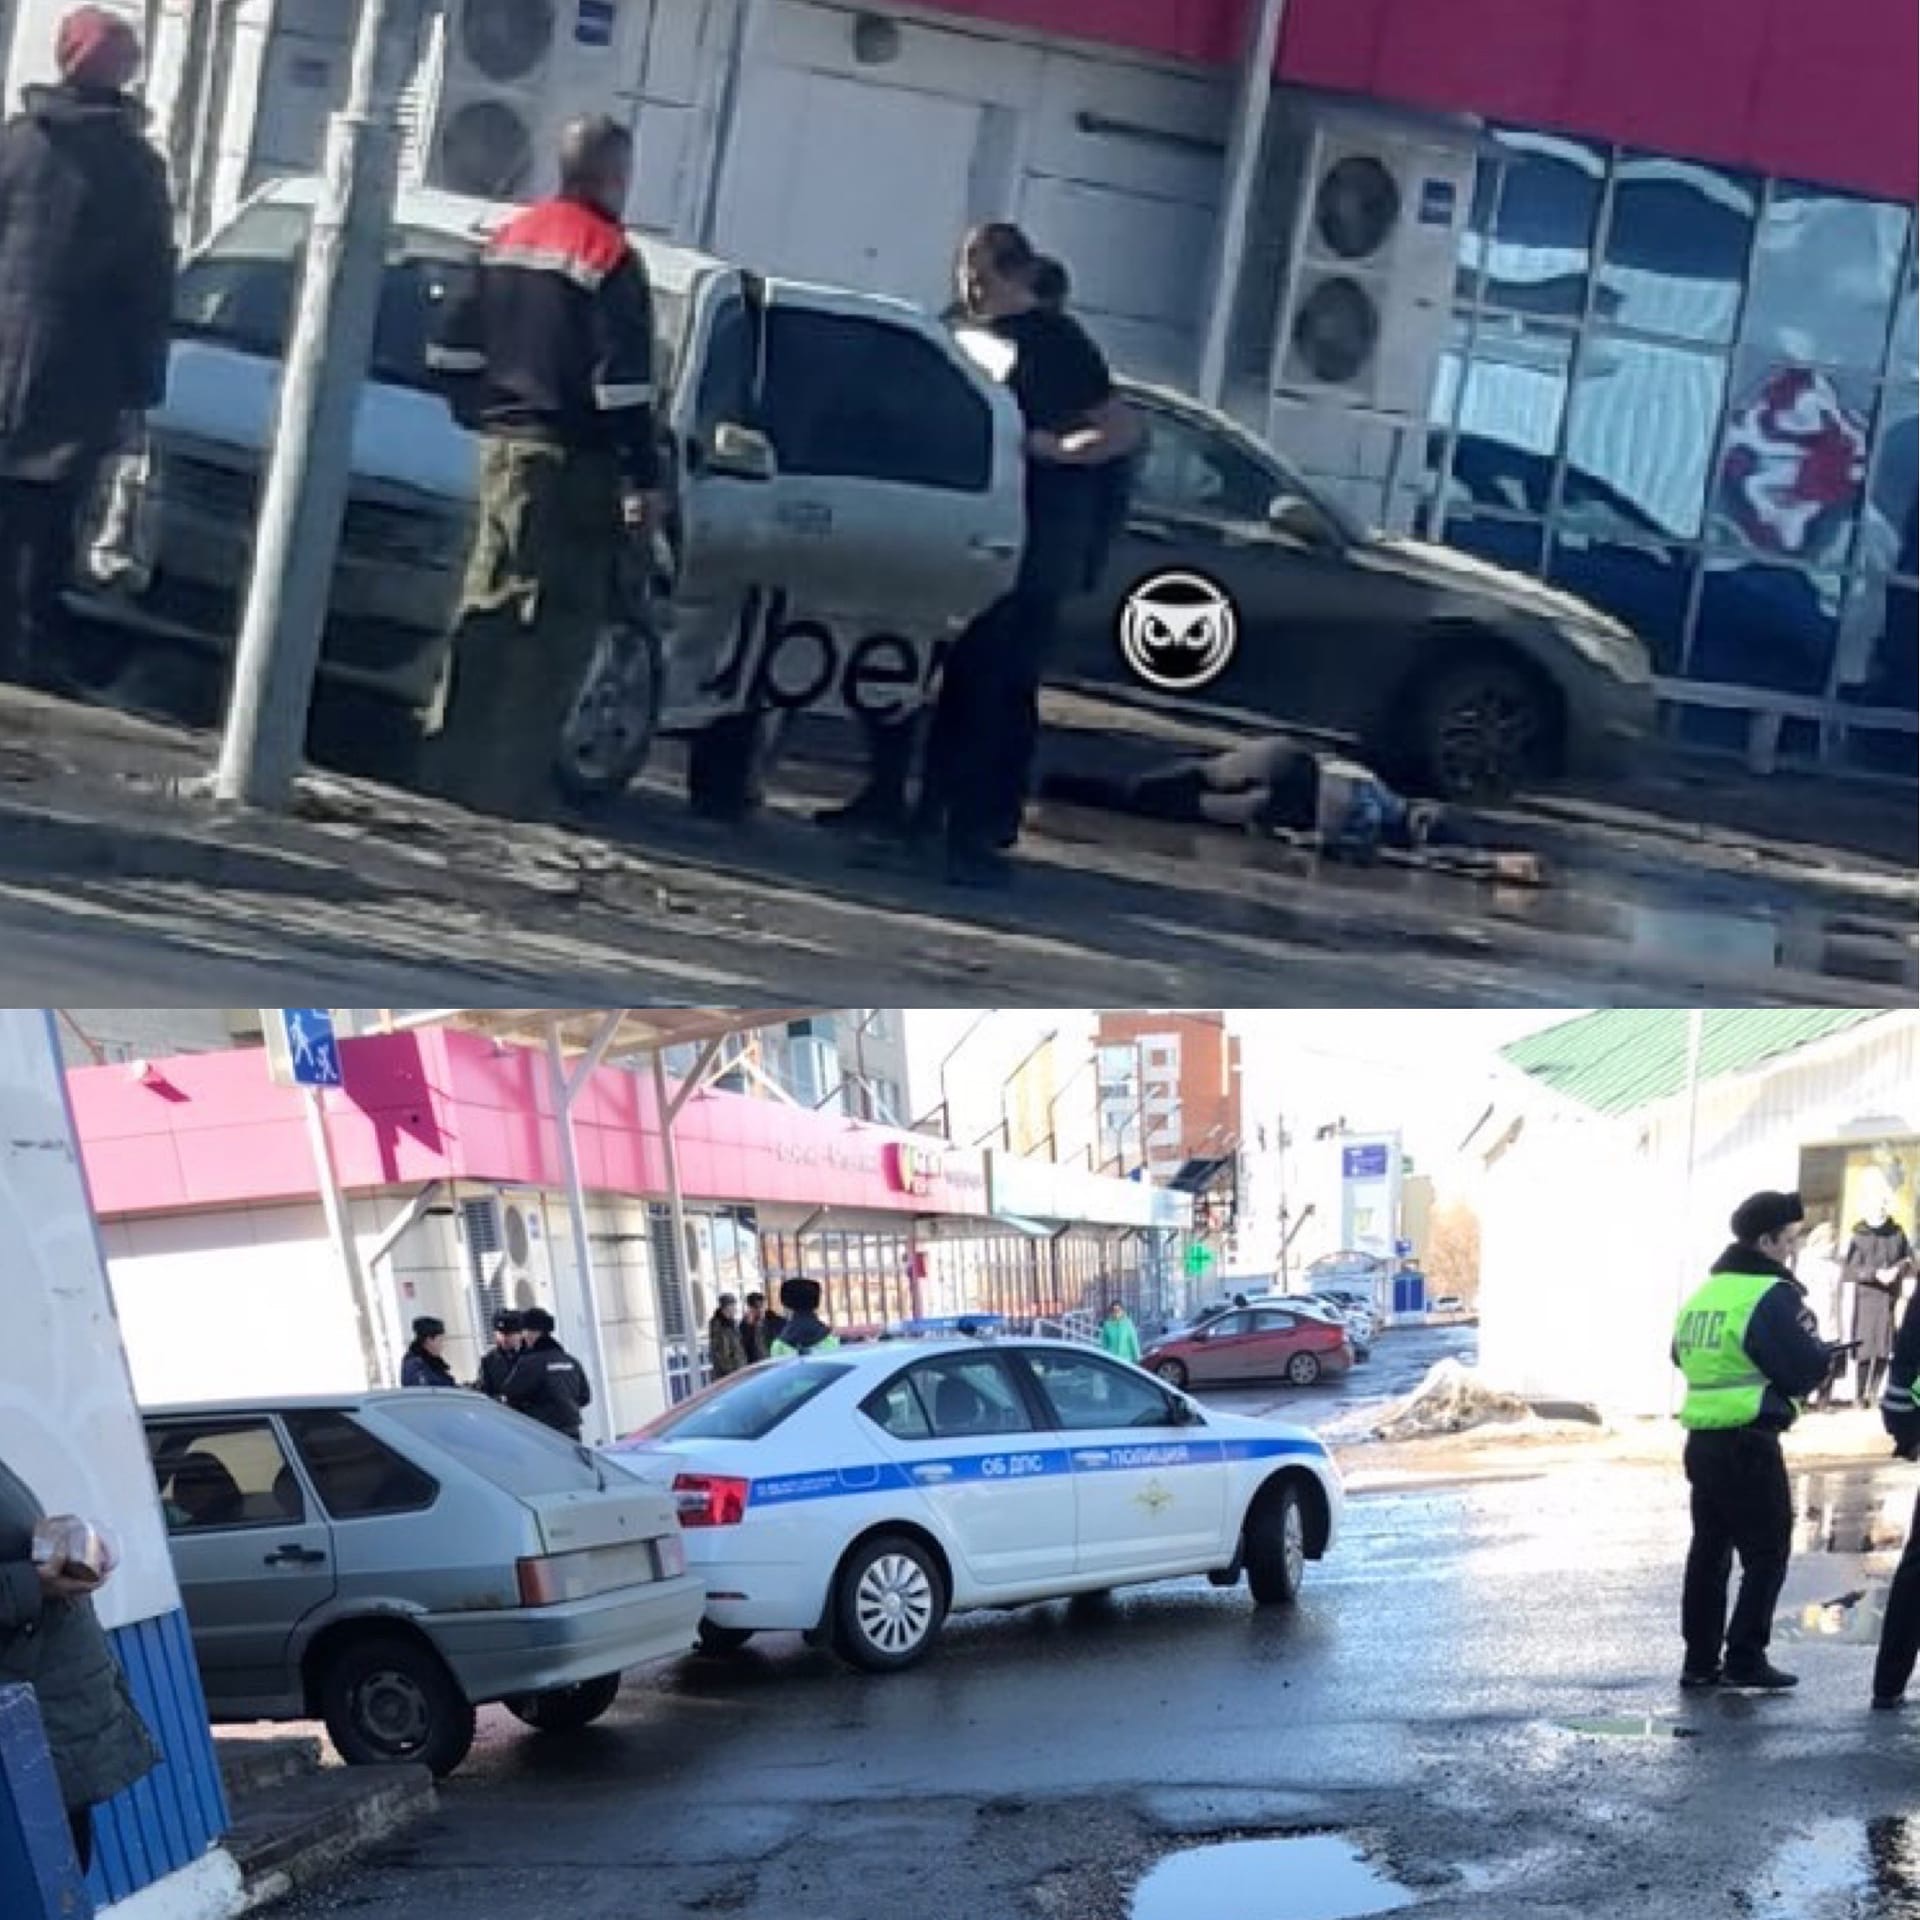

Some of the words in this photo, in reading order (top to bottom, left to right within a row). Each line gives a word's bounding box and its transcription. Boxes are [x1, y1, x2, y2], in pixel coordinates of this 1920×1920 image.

[1679, 1310, 1726, 1355] ДПС
[982, 1457, 1007, 1476] ОБ
[1009, 1454, 1043, 1476] ДПС
[1111, 1444, 1188, 1466] ПОЛИЦИЯ
